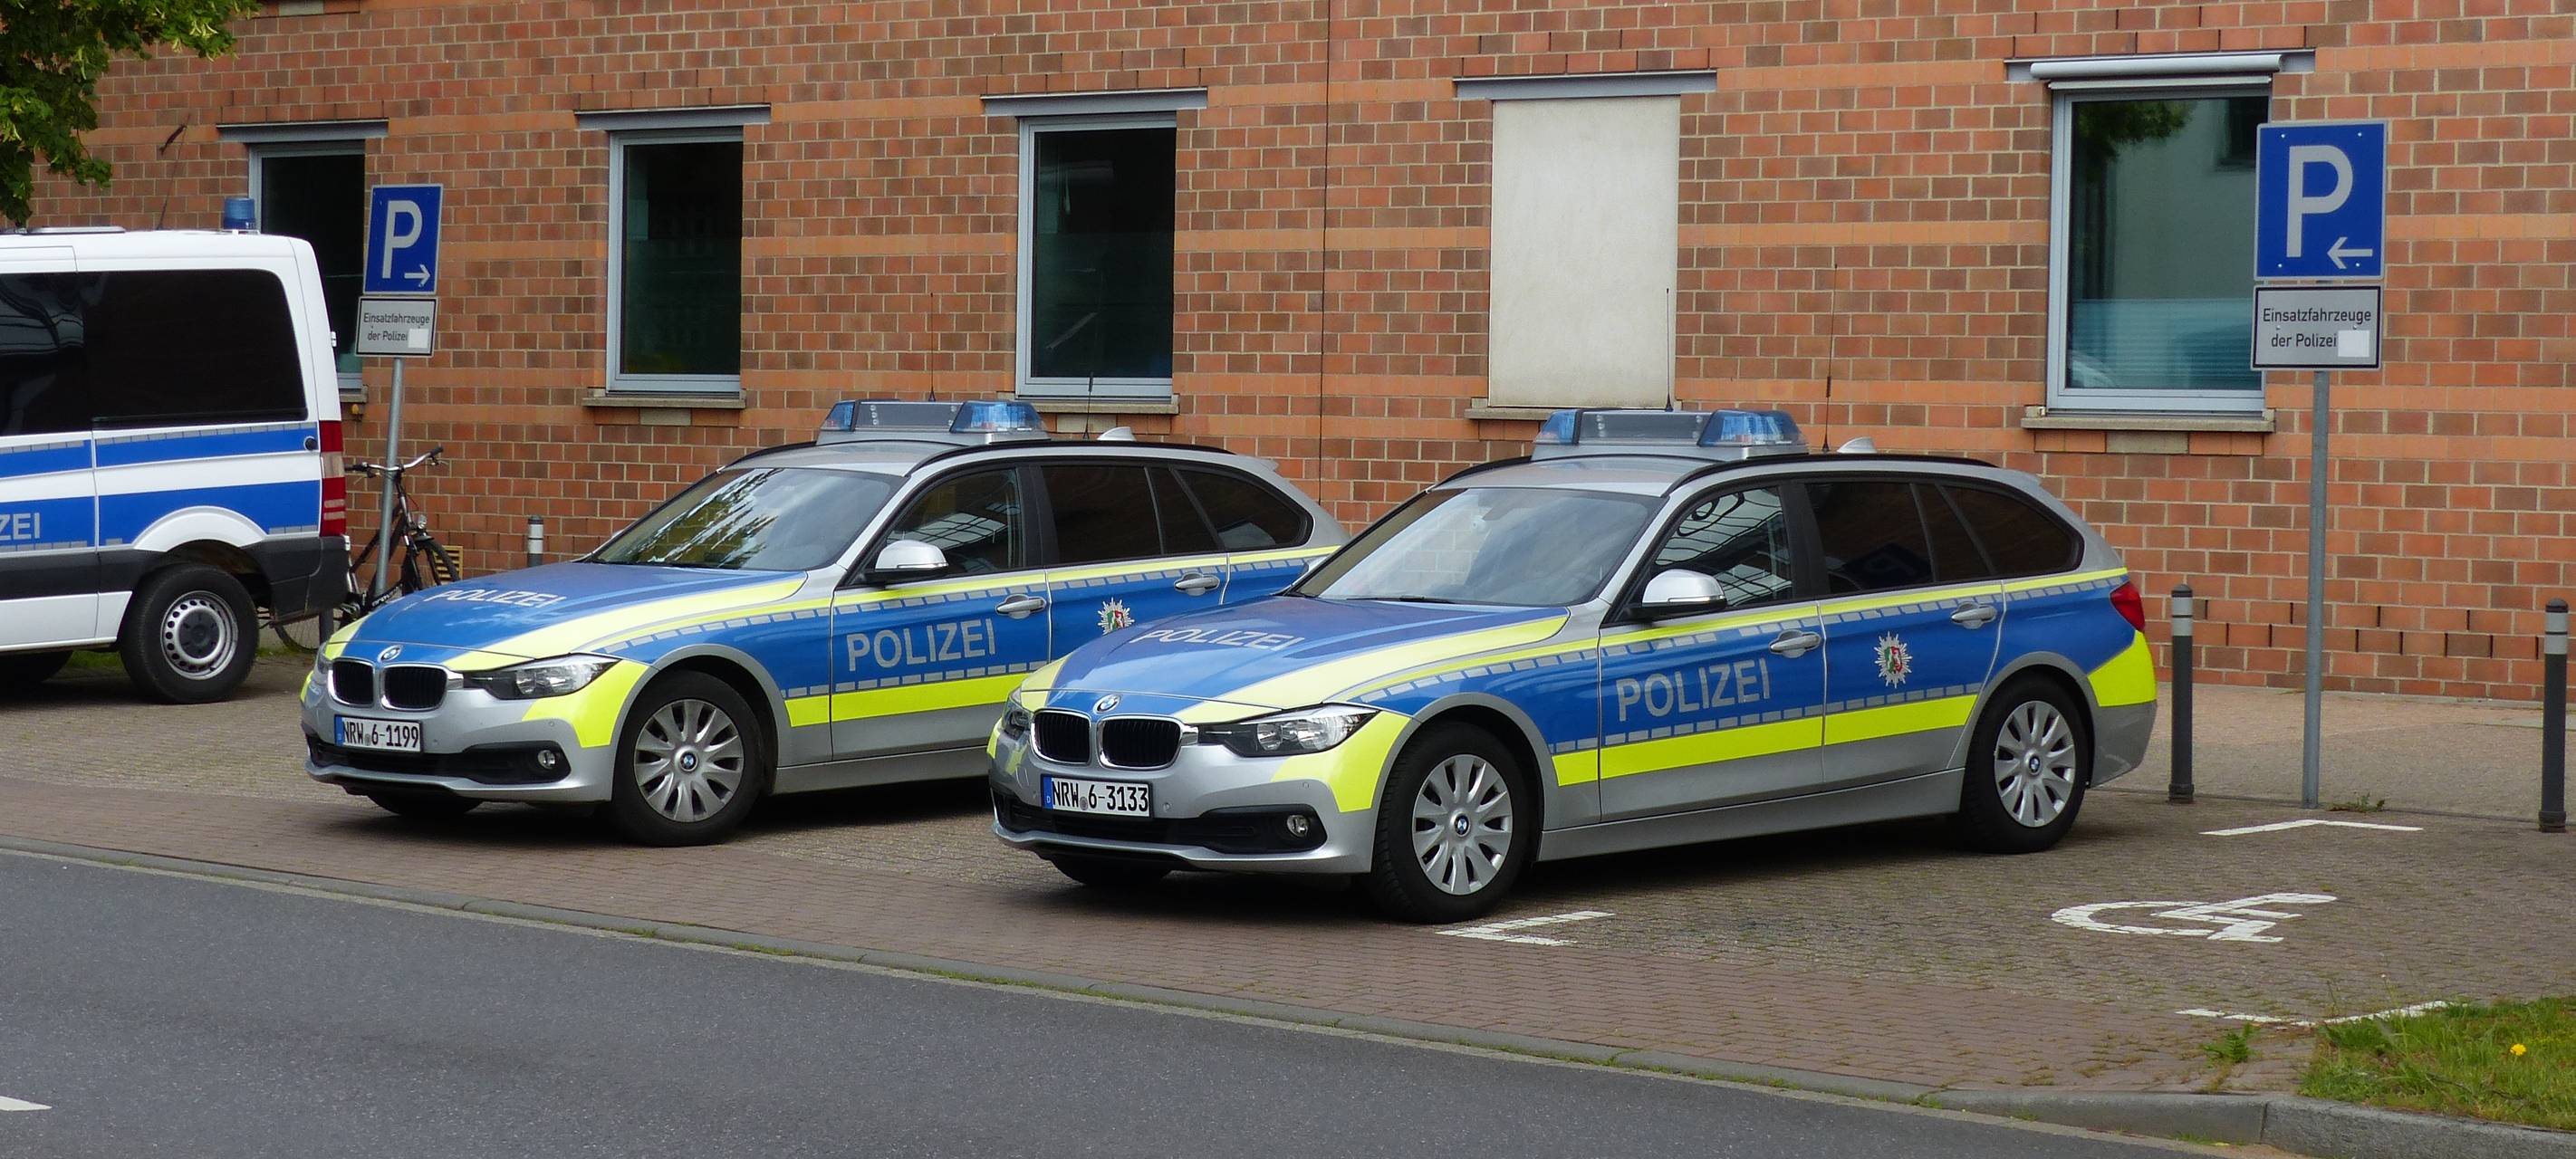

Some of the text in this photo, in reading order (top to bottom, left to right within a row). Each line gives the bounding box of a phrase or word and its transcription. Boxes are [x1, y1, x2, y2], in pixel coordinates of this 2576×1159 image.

[2286, 145, 2353, 258] P
[382, 199, 423, 279] P
[363, 312, 430, 326] Einsatzfahrzeuge
[2263, 308, 2371, 324] Einsatzfahrzeuge
[367, 330, 380, 341] der
[2271, 333, 2337, 347] der Polizei
[423, 589, 568, 608] POLIZEI
[846, 618, 995, 672] POLIZEI
[1129, 629, 1305, 651] POLIZEI
[1616, 657, 1770, 722] POLIZEI
[343, 722, 418, 748] NRW 6-1199
[1052, 781, 1149, 812] NRW 6-3133
